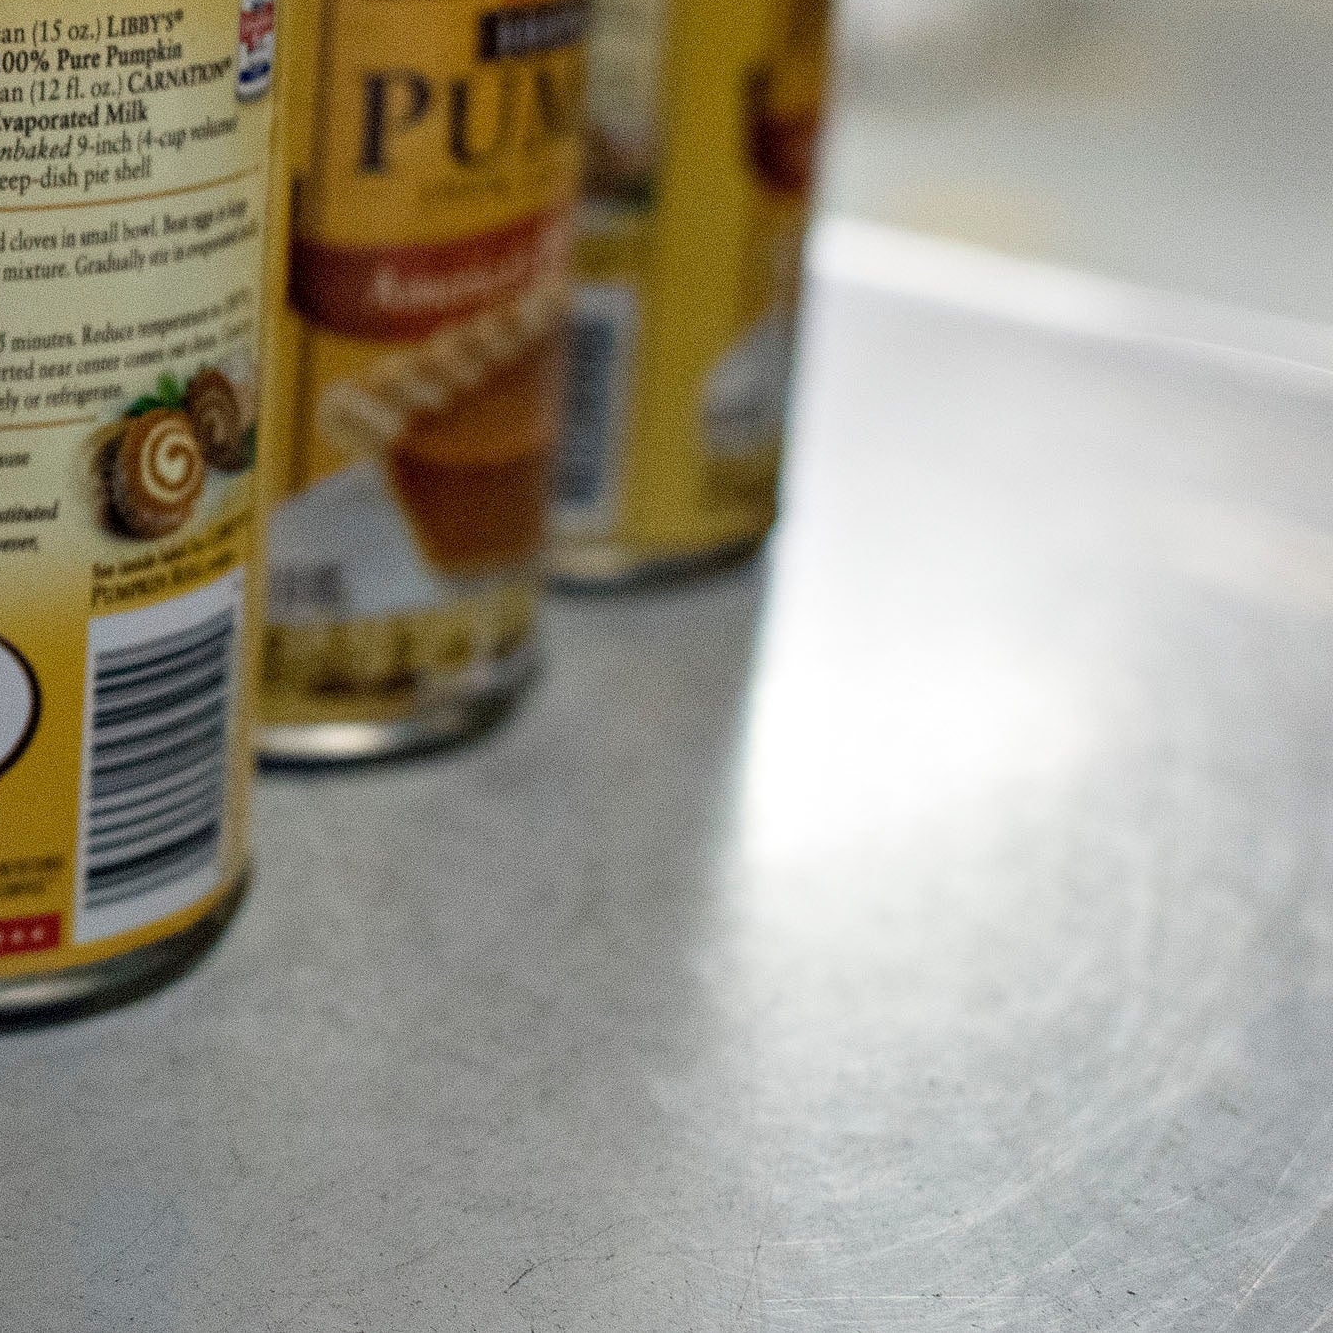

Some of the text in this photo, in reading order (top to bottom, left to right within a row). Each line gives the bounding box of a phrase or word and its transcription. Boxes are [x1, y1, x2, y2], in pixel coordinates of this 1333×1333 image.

[32, 18, 63, 47] (15
[66, 16, 103, 44] oz.)
[56, 45, 102, 73] Pure
[106, 38, 183, 73] Pumpkin
[29, 78, 61, 108] (12
[63, 75, 85, 102] fl.
[89, 73, 124, 101] oz.)
[104, 98, 149, 126] Milk
[76, 127, 132, 157] 9-inch
[83, 165, 110, 193] pie
[114, 154, 153, 181] shell
[8, 227, 58, 253] cloves
[60, 224, 77, 250] in
[79, 220, 120, 248] small
[2, 259, 72, 284] mixture.
[10, 330, 76, 353] minutes.
[80, 320, 136, 345] Reduce
[38, 360, 73, 379] near
